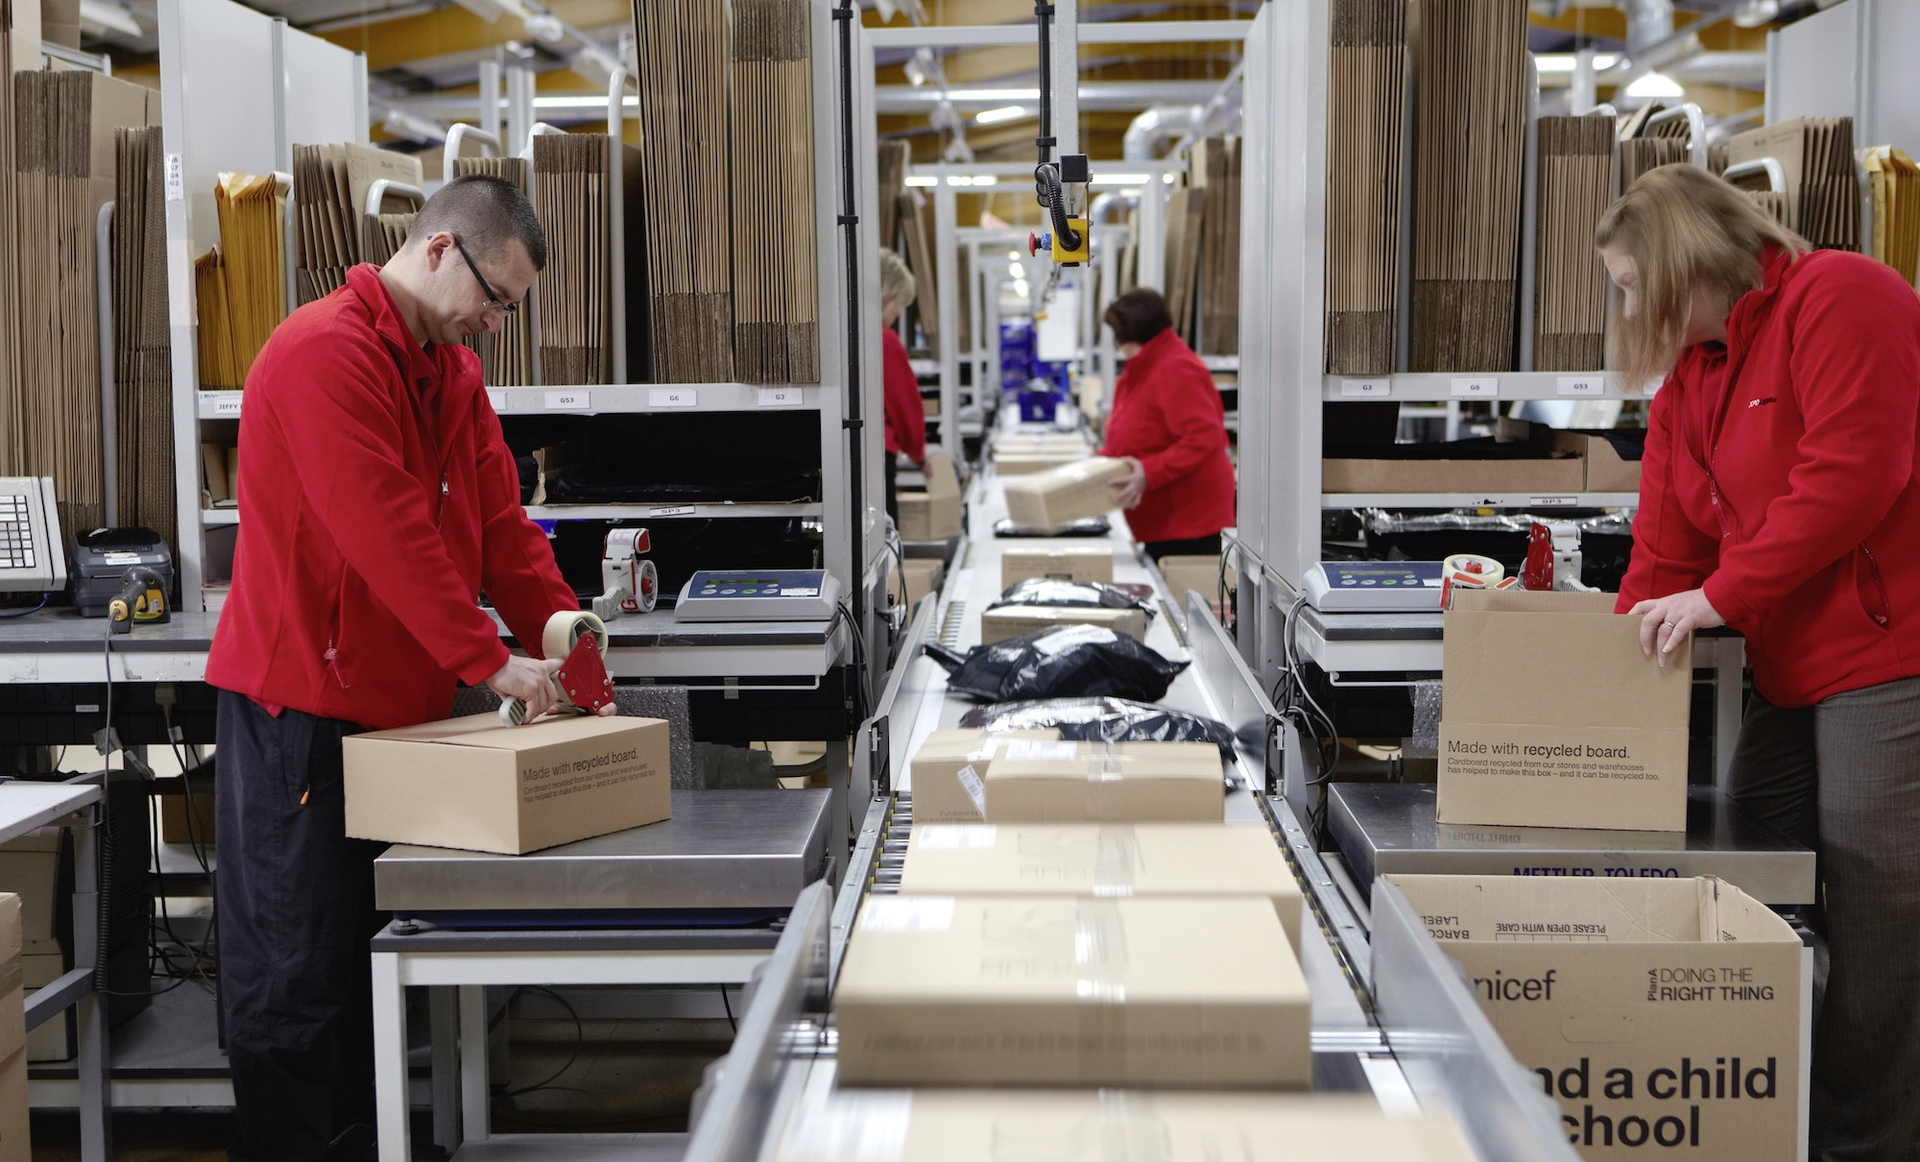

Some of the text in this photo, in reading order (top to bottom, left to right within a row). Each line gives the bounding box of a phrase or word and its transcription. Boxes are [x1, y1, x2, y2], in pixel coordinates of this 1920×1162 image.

[1448, 740, 1630, 758] Made with recycled board.
[523, 767, 550, 782] Made
[552, 761, 570, 776] with
[573, 753, 609, 772] recycled
[1448, 757, 1487, 766] Cardboard
[1490, 760, 1522, 768] recycled
[1463, 767, 1488, 776] helped
[1420, 916, 1459, 925] LABEL
[1496, 923, 1606, 933] PLEASE OPEN WITH CARE
[1661, 968, 1752, 983] DOING THE
[1473, 969, 1556, 1001] nicef
[1661, 986, 1774, 1001] RIGHT THING
[1604, 1068, 1633, 1099] a
[1647, 1057, 1776, 1099] child
[1561, 1105, 1700, 1146] chool
